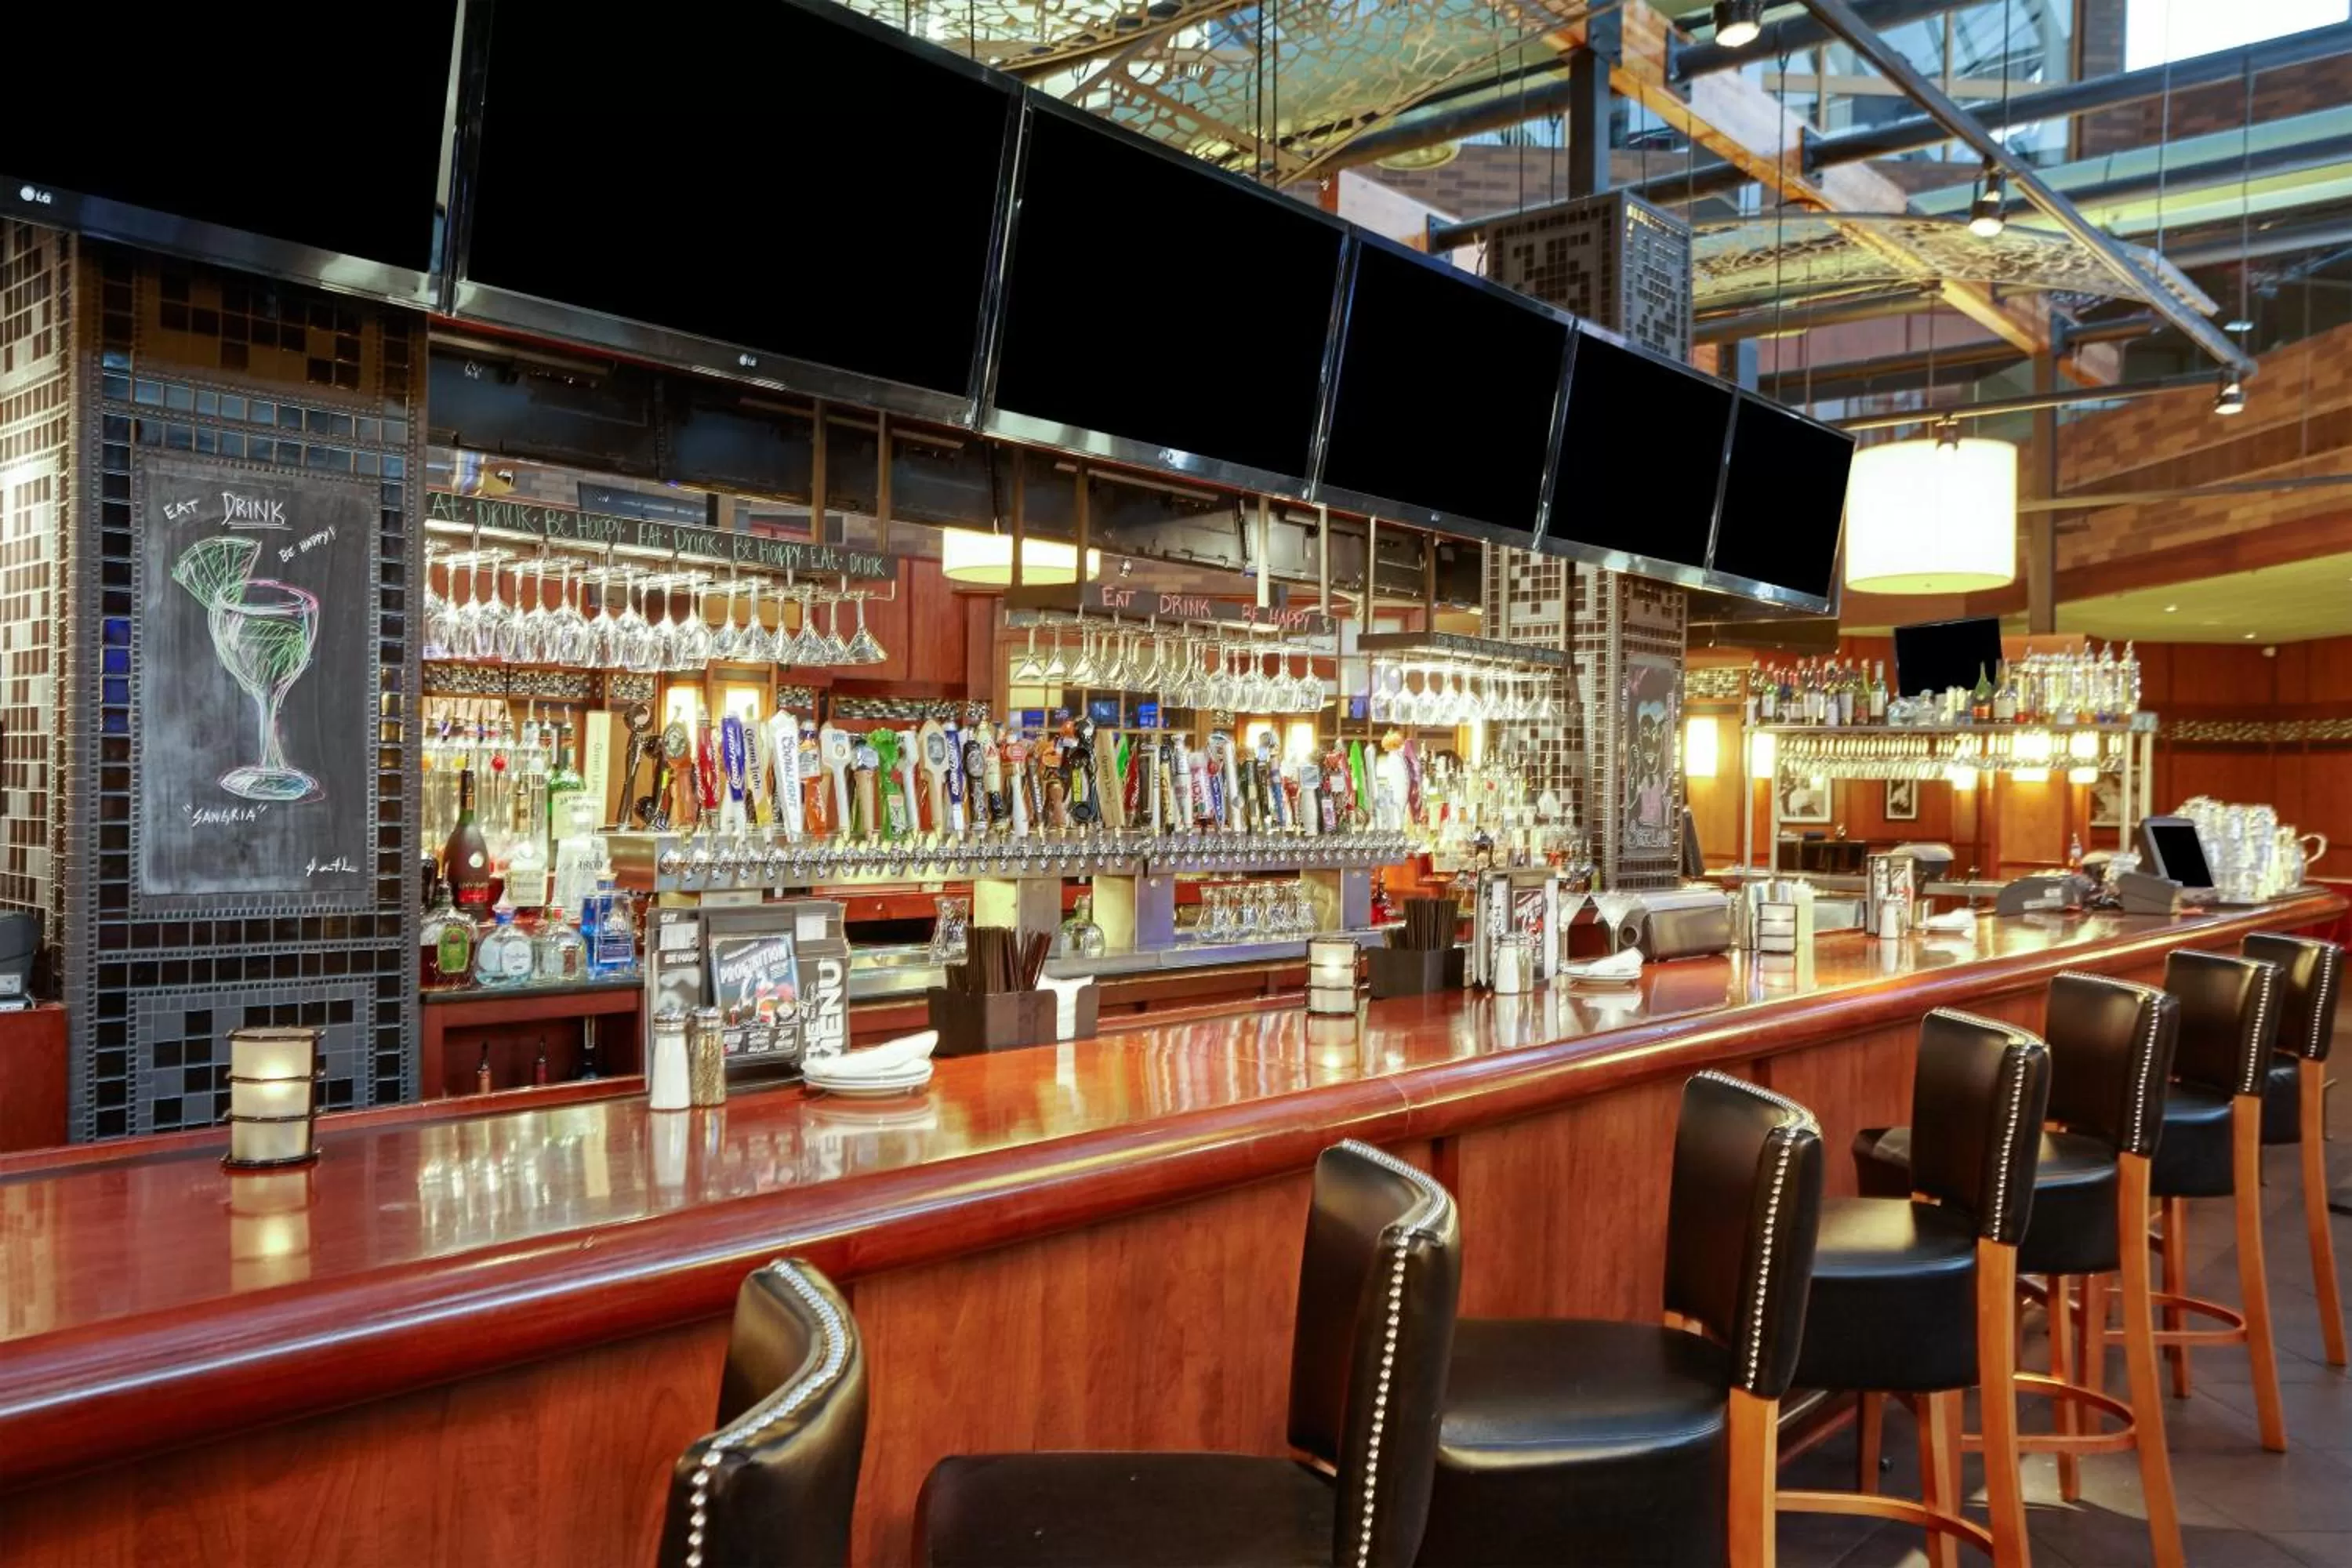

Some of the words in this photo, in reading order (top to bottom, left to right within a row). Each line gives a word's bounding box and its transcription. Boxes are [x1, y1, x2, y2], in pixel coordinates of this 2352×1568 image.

[163, 499, 199, 521] EAT
[221, 491, 288, 525] DRINK
[1102, 586, 1136, 608] EAT
[1160, 594, 1213, 619] DRINK
[1268, 607, 1311, 631] HAPPY
